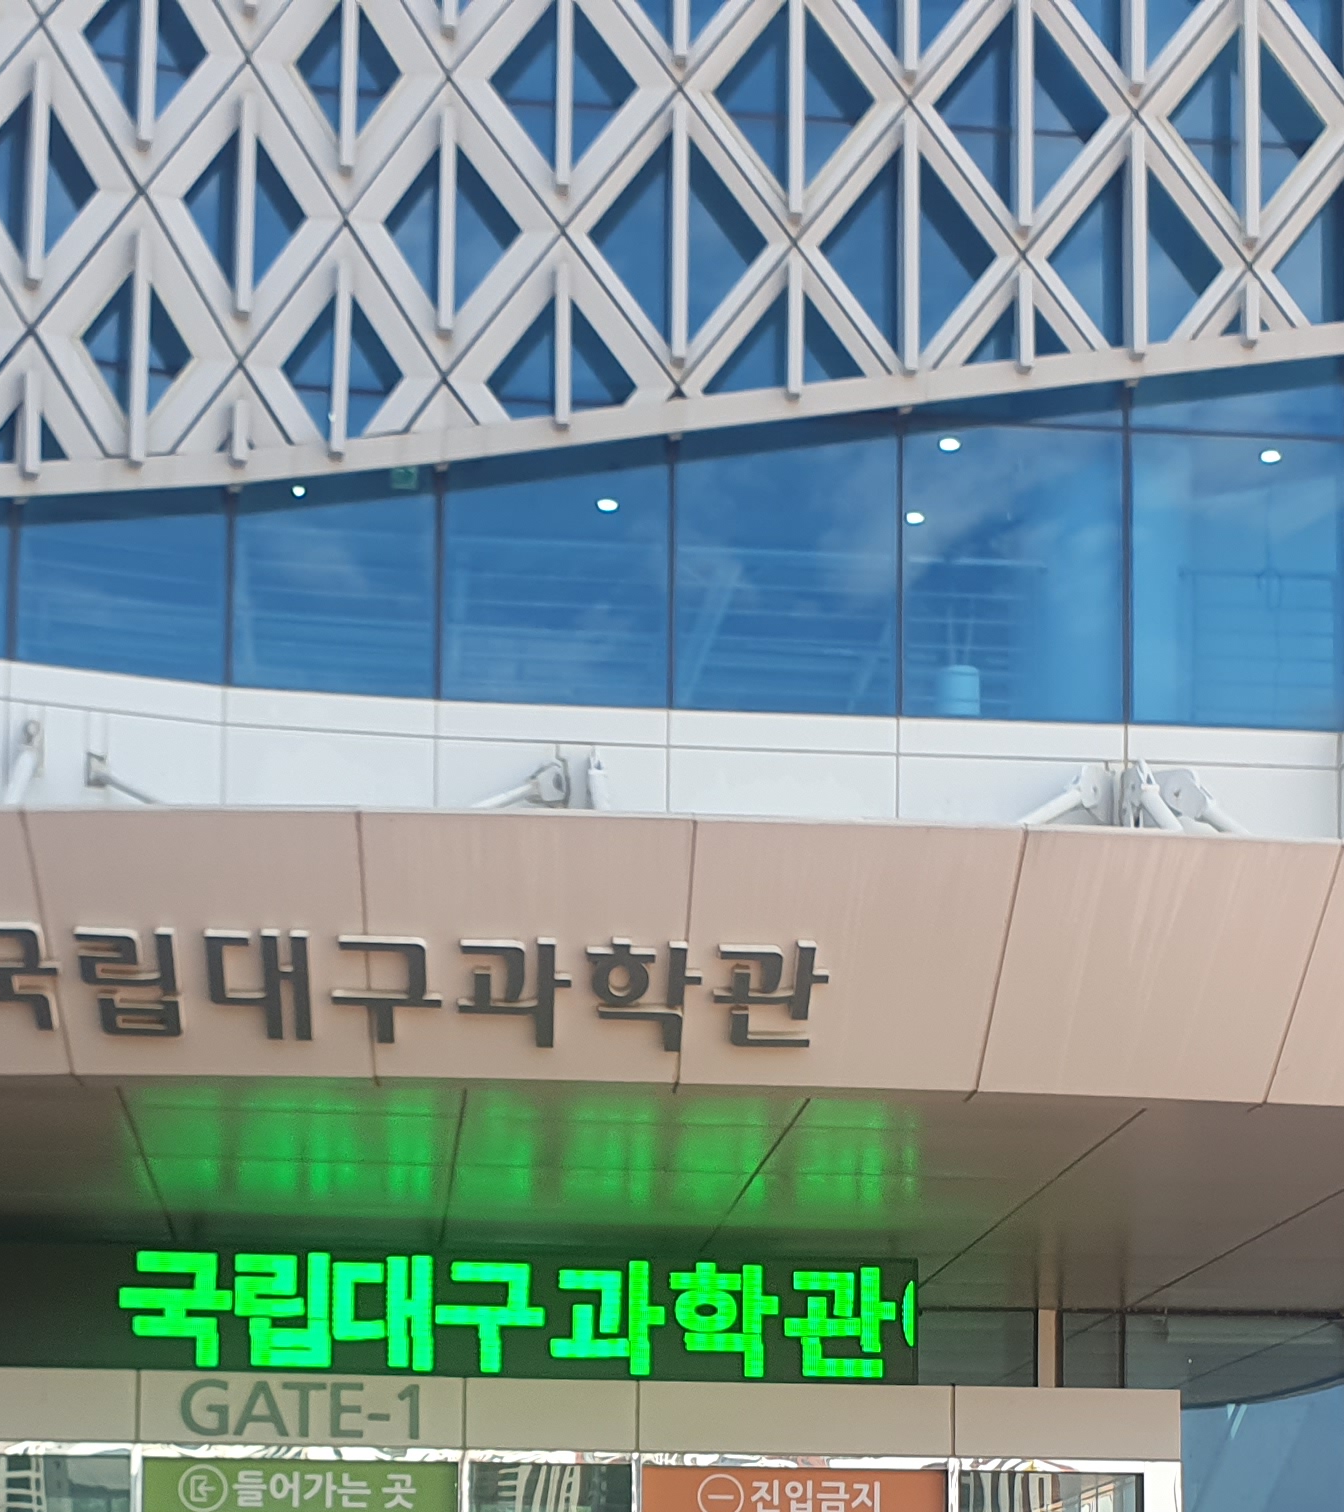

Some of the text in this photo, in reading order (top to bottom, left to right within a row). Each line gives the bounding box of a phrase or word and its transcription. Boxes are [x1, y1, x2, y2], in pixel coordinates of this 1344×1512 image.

[119, 1250, 918, 1380] 국립대구과학관
[181, 1379, 423, 1440] GATE-1
[233, 1466, 418, 1510] 들어가는 곳
